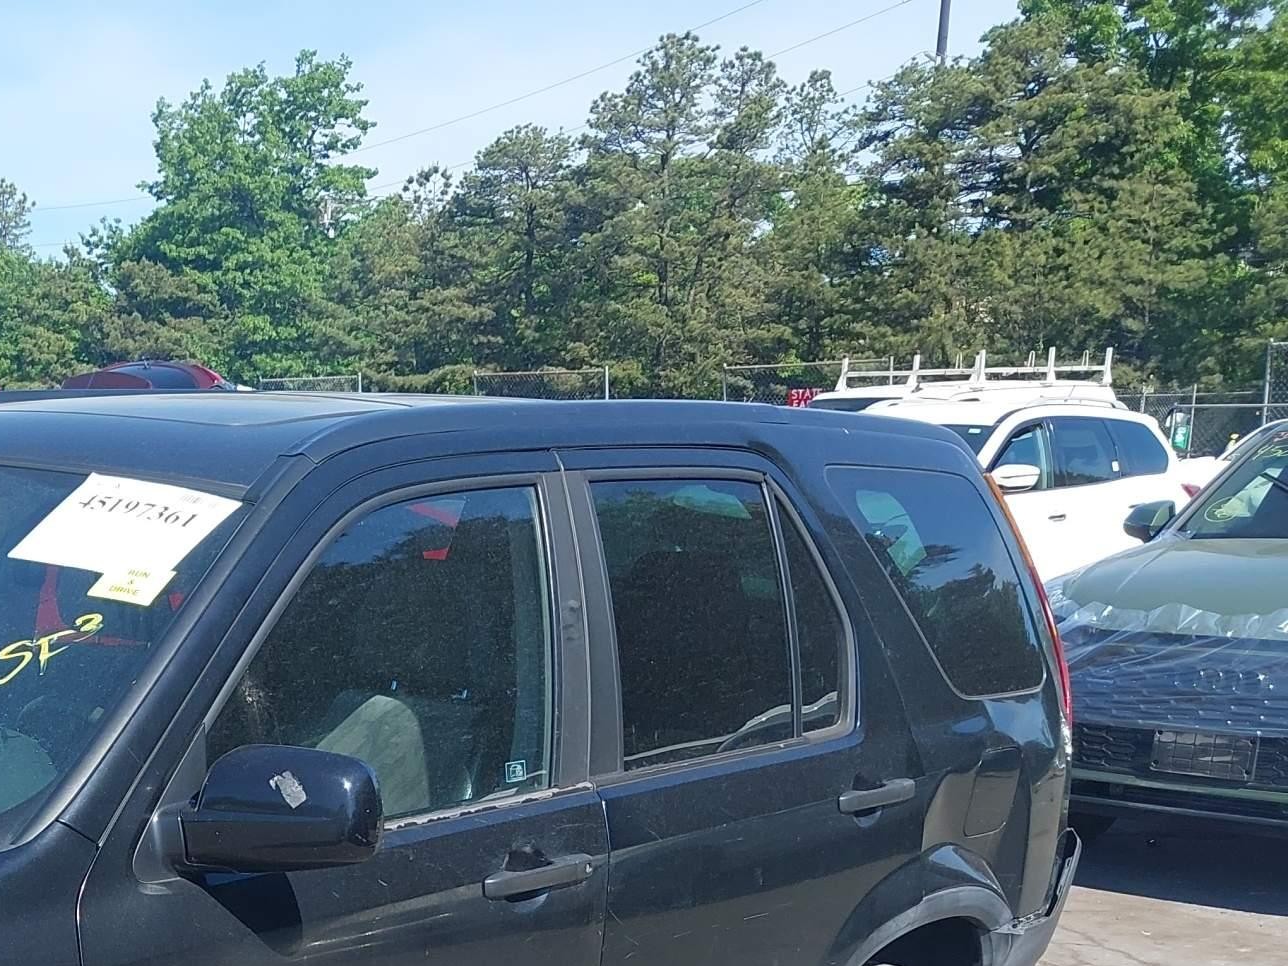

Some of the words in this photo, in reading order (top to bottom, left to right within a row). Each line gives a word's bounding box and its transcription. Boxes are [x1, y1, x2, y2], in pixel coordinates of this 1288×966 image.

[79, 494, 198, 528] 45197361
[127, 568, 151, 578] RUN
[109, 584, 141, 596] DRIVE
